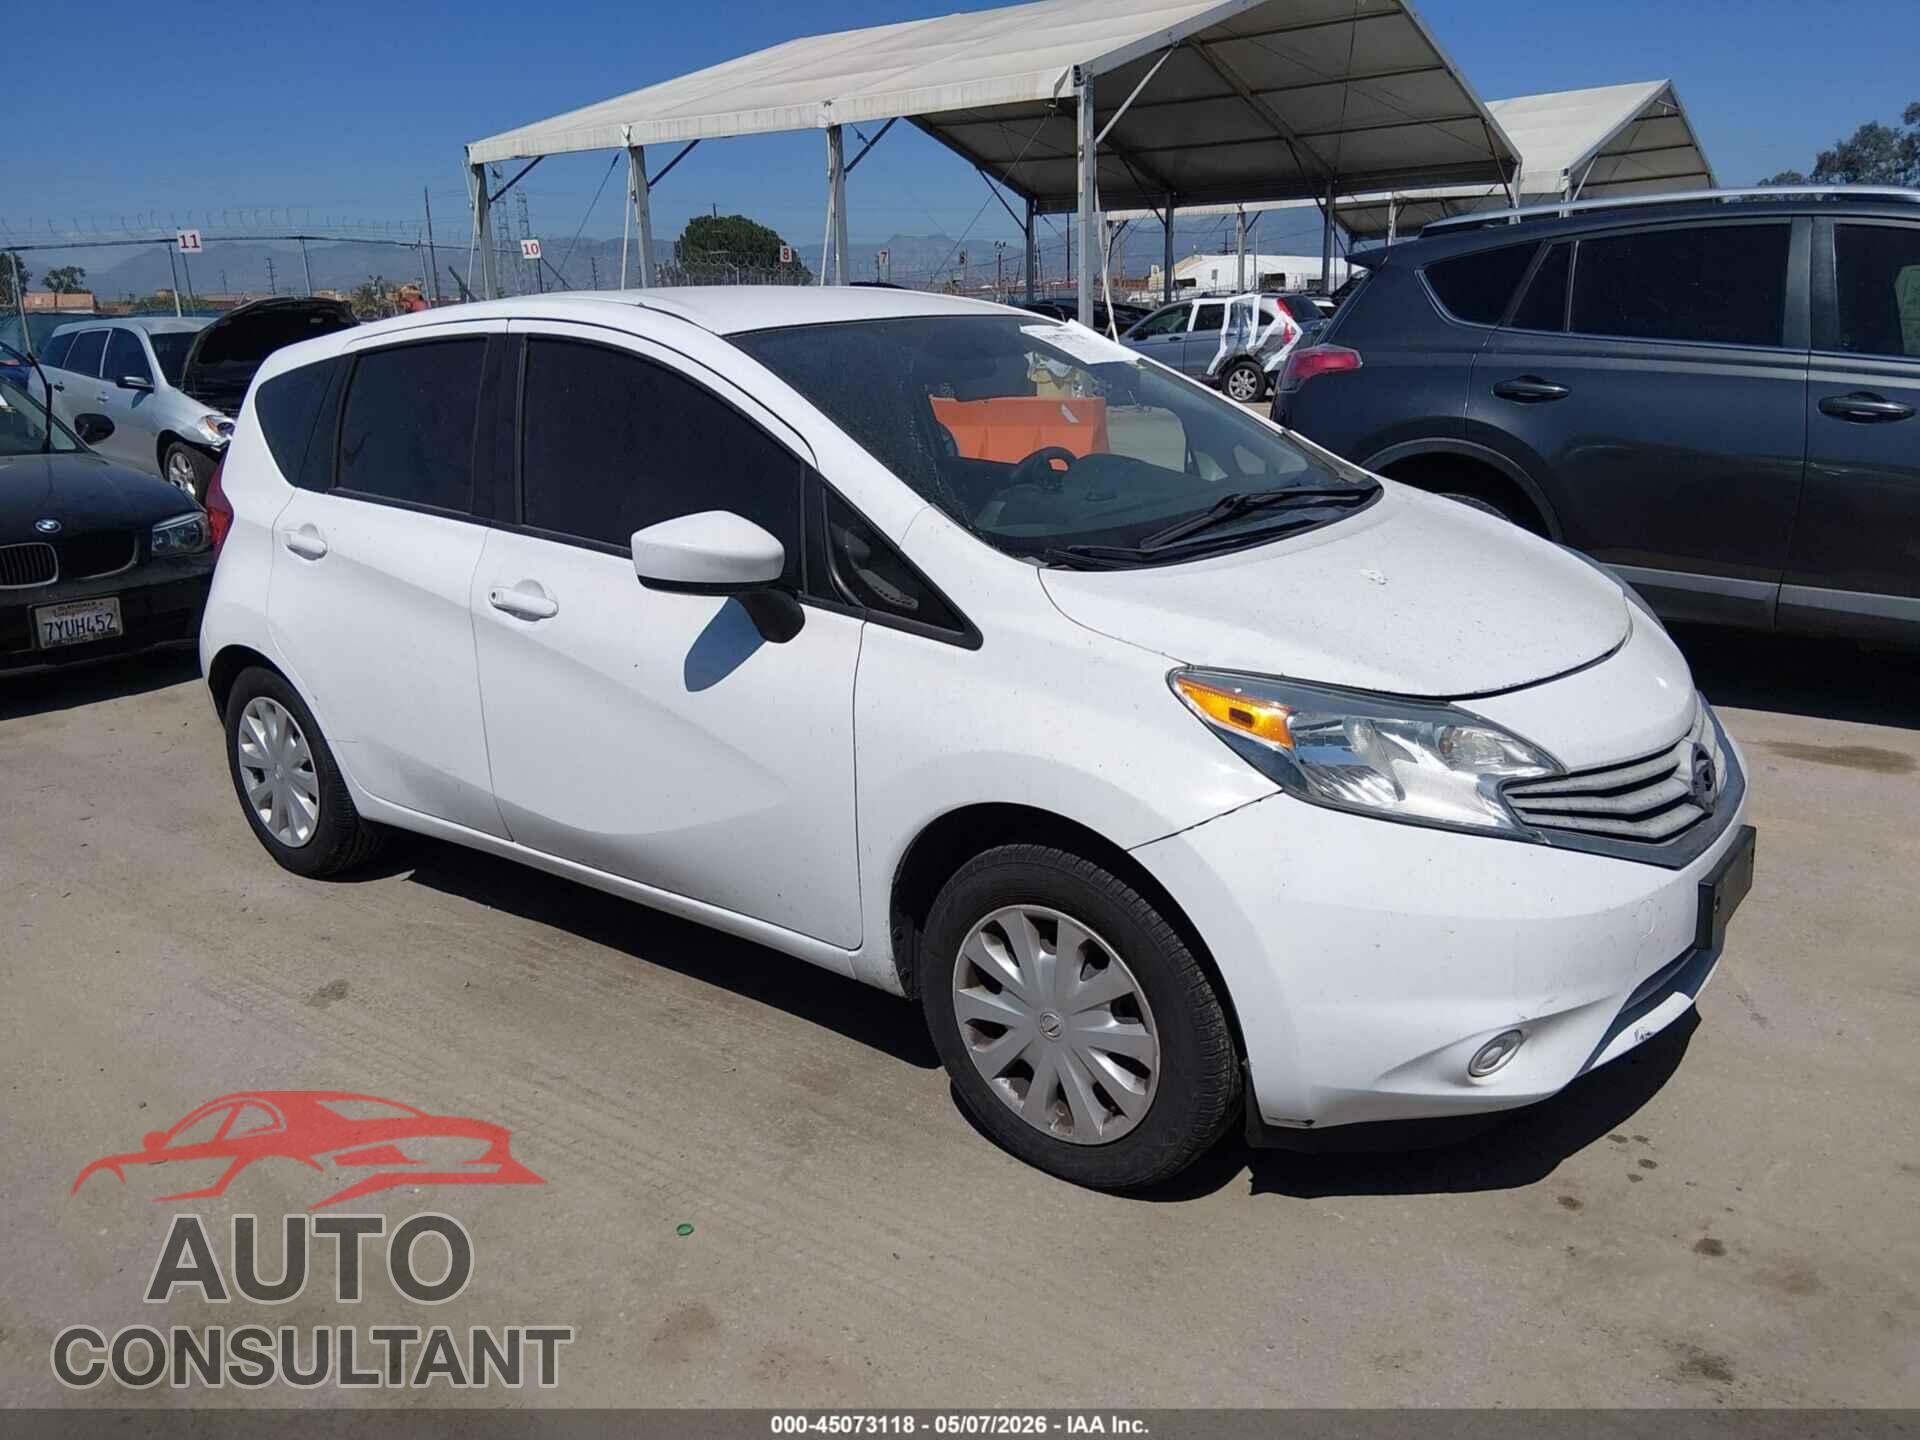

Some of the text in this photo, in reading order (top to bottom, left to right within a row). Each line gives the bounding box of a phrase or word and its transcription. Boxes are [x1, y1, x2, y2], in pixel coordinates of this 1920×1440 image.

[179, 234, 201, 249] 11
[523, 243, 539, 255] 10
[880, 251, 888, 264] 7
[44, 612, 116, 641] 7YUH452
